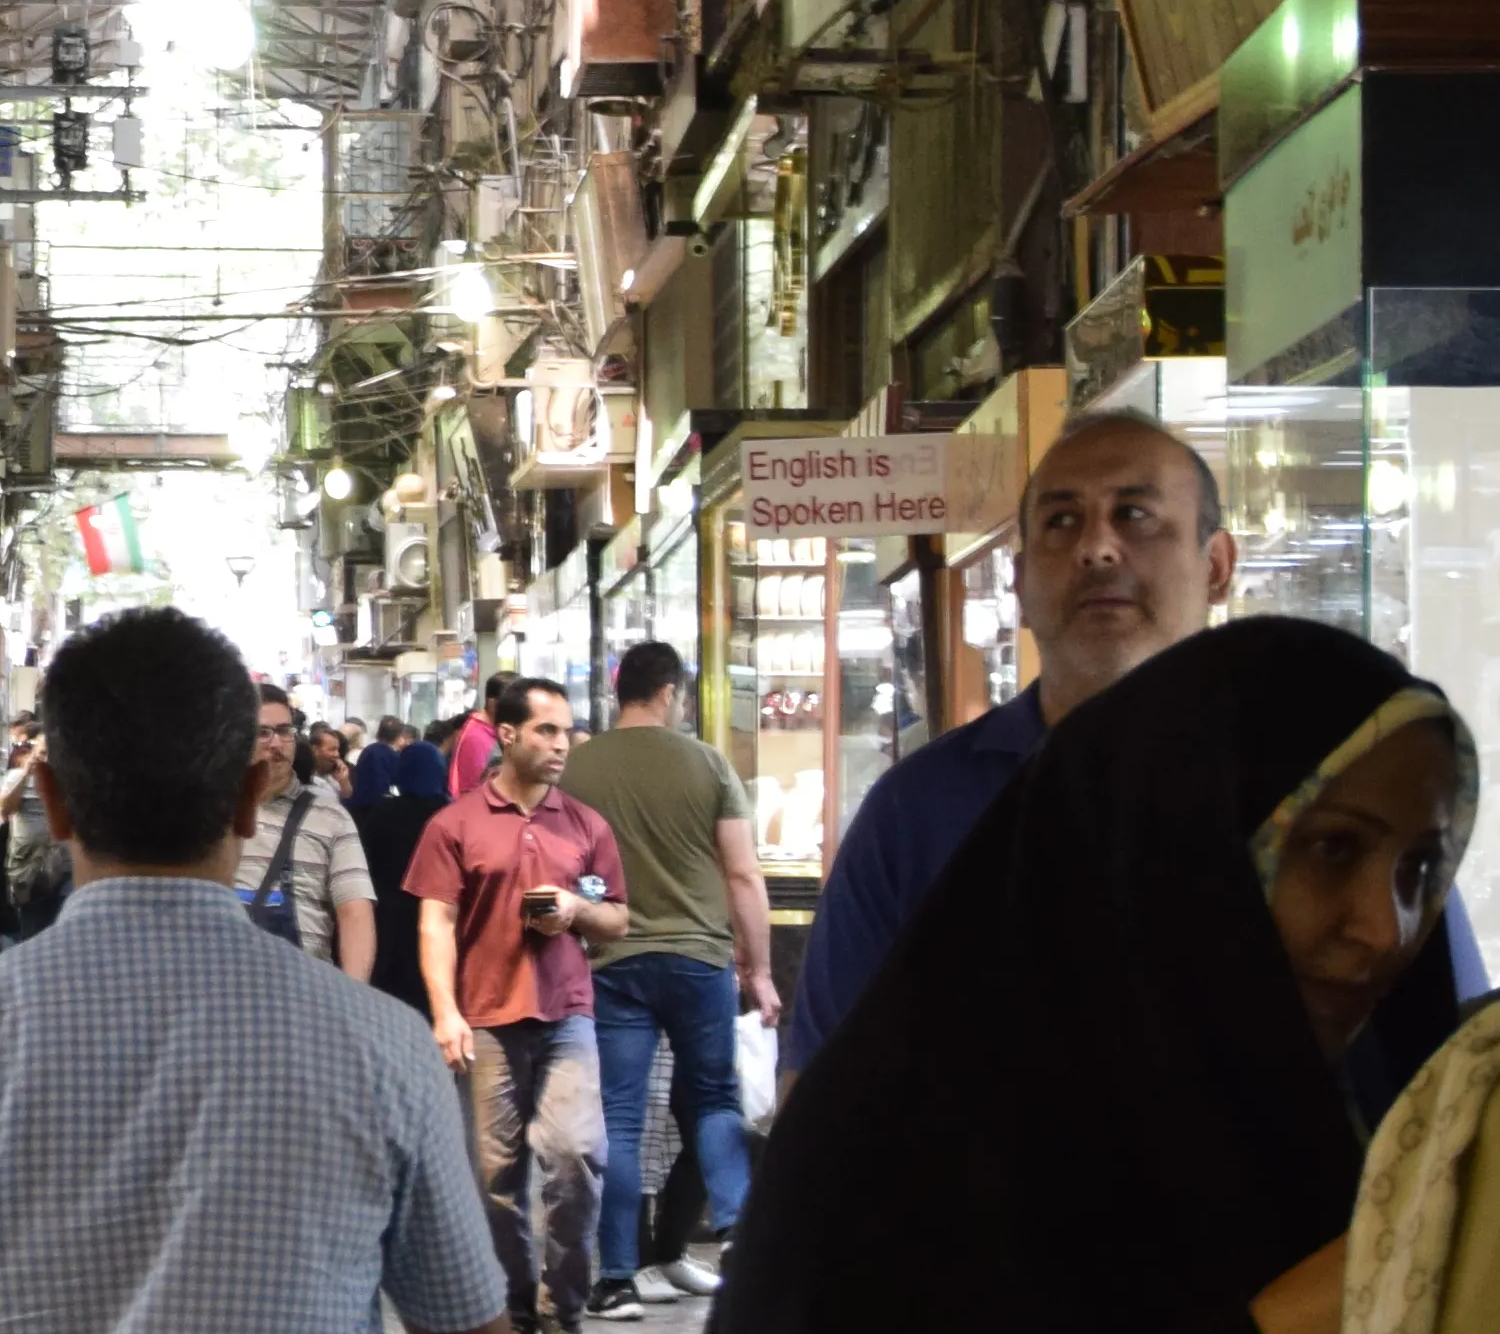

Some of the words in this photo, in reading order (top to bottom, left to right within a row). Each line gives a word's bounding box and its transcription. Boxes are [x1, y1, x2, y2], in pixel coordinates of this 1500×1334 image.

[749, 449, 856, 487] English
[867, 448, 891, 477] is
[753, 496, 863, 533] Spoken
[876, 492, 946, 523] Here
